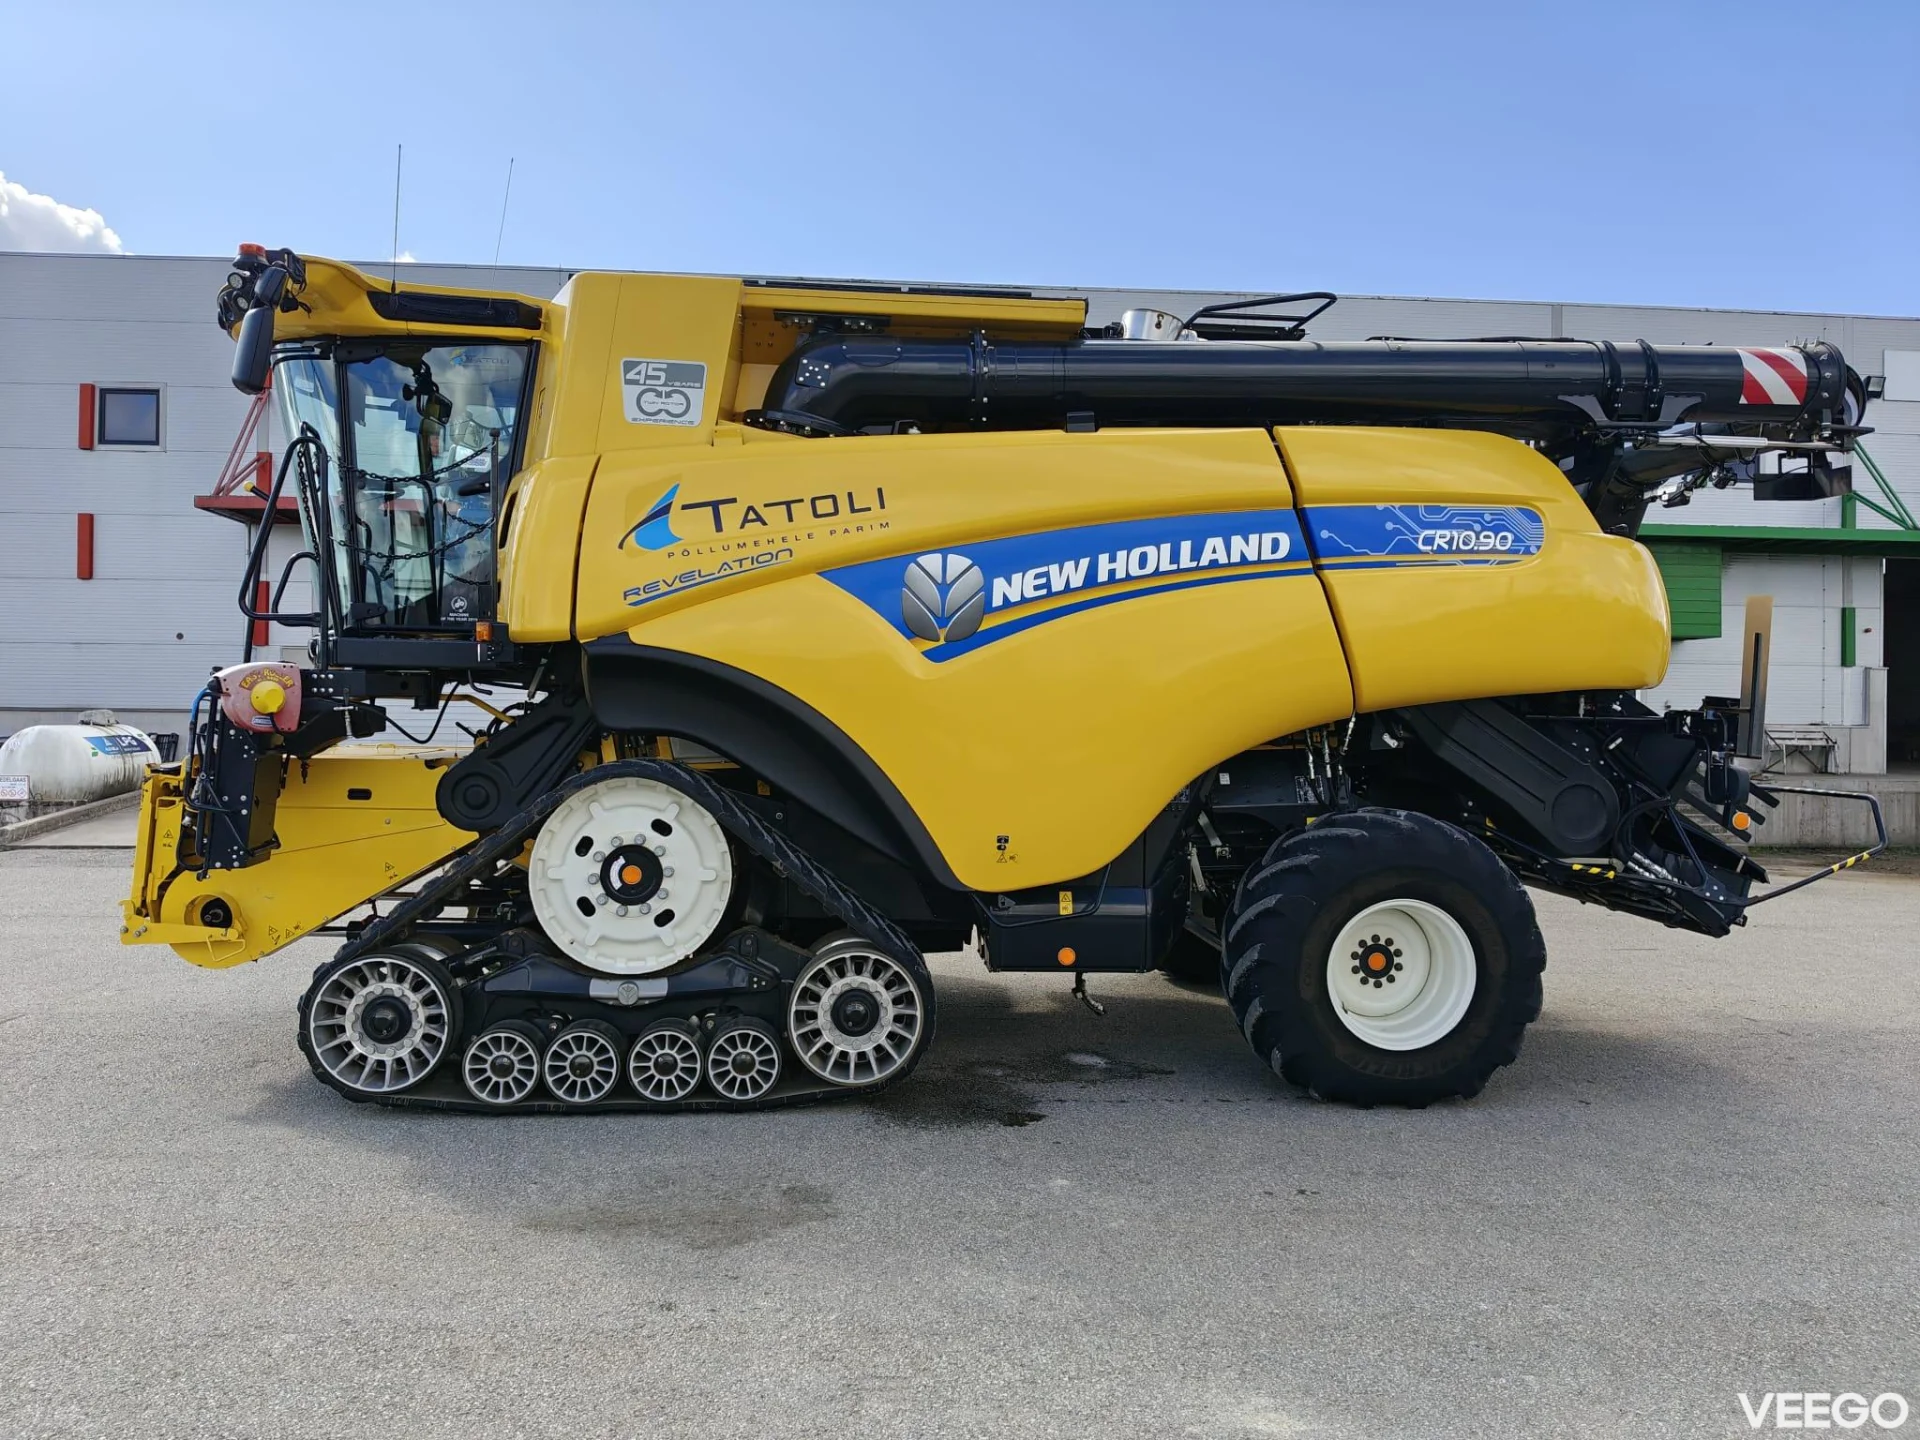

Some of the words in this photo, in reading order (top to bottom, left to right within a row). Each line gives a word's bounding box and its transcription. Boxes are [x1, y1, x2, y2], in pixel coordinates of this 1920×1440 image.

[625, 362, 668, 386] 45
[667, 380, 701, 388] YEARS
[631, 417, 695, 426] EXPERIENCE
[680, 487, 886, 533] TATOLI
[667, 532, 815, 559] PÕLLUMEHELE
[829, 521, 891, 537] PARIM
[1417, 529, 1513, 551] CR10.90
[623, 547, 793, 601] REVELATION
[991, 556, 1092, 609] NEW
[1097, 531, 1291, 583] HOLLAND
